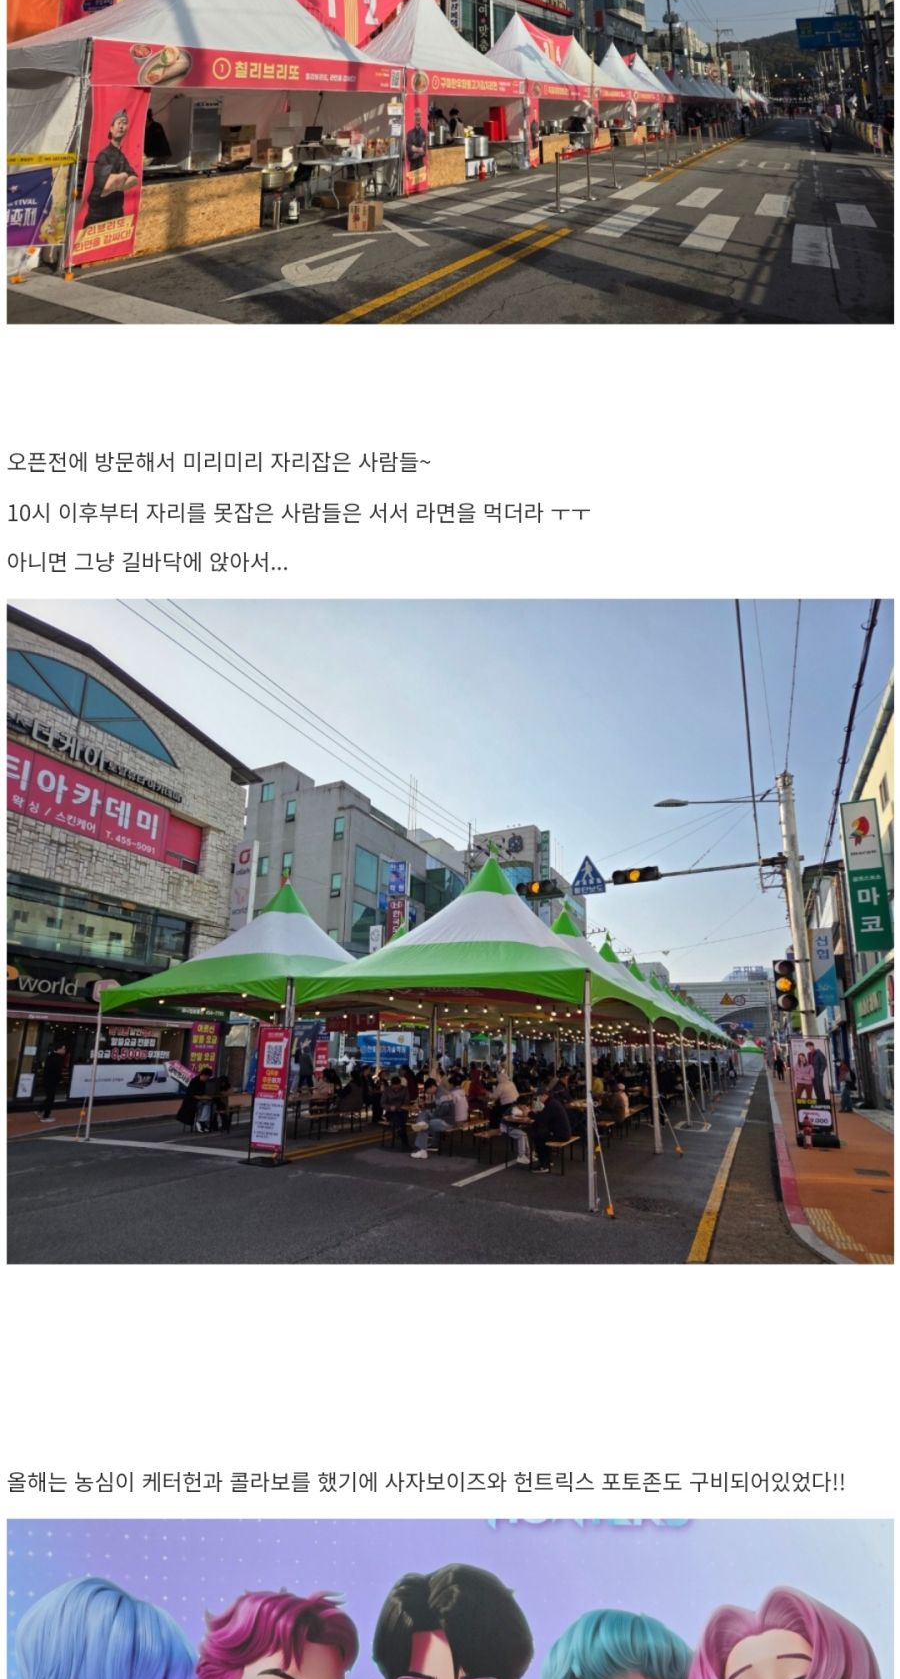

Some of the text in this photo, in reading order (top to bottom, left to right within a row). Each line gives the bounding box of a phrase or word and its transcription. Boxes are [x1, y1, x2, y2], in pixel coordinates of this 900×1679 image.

[234, 61, 300, 80] 칠리브리또
[7, 754, 159, 840] 티아카데미
[56, 812, 96, 833] 스킨케어
[816, 934, 830, 961] 신협
[18, 977, 79, 996] world
